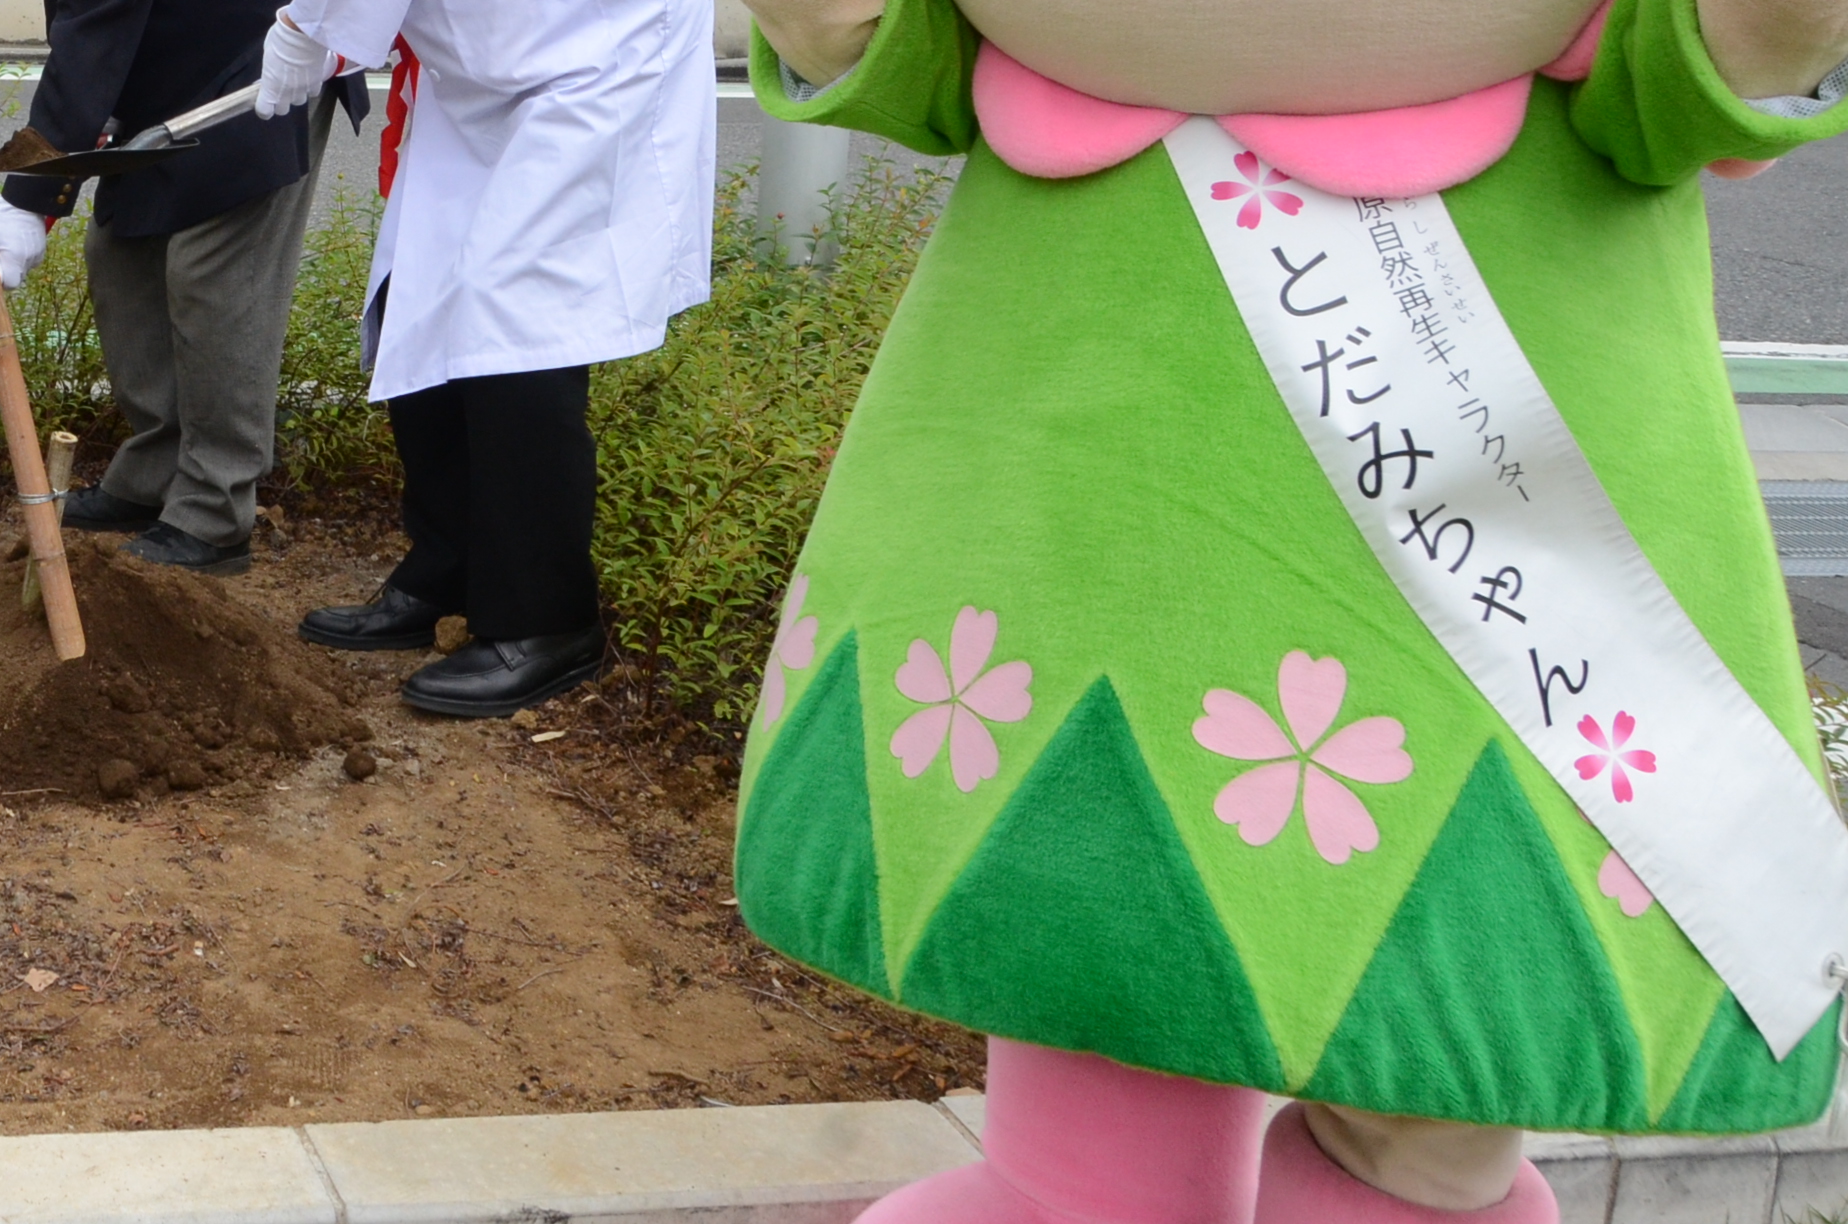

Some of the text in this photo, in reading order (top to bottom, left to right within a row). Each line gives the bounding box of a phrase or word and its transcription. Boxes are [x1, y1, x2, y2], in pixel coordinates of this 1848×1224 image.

[1269, 244, 1590, 728] とだみちゃん
